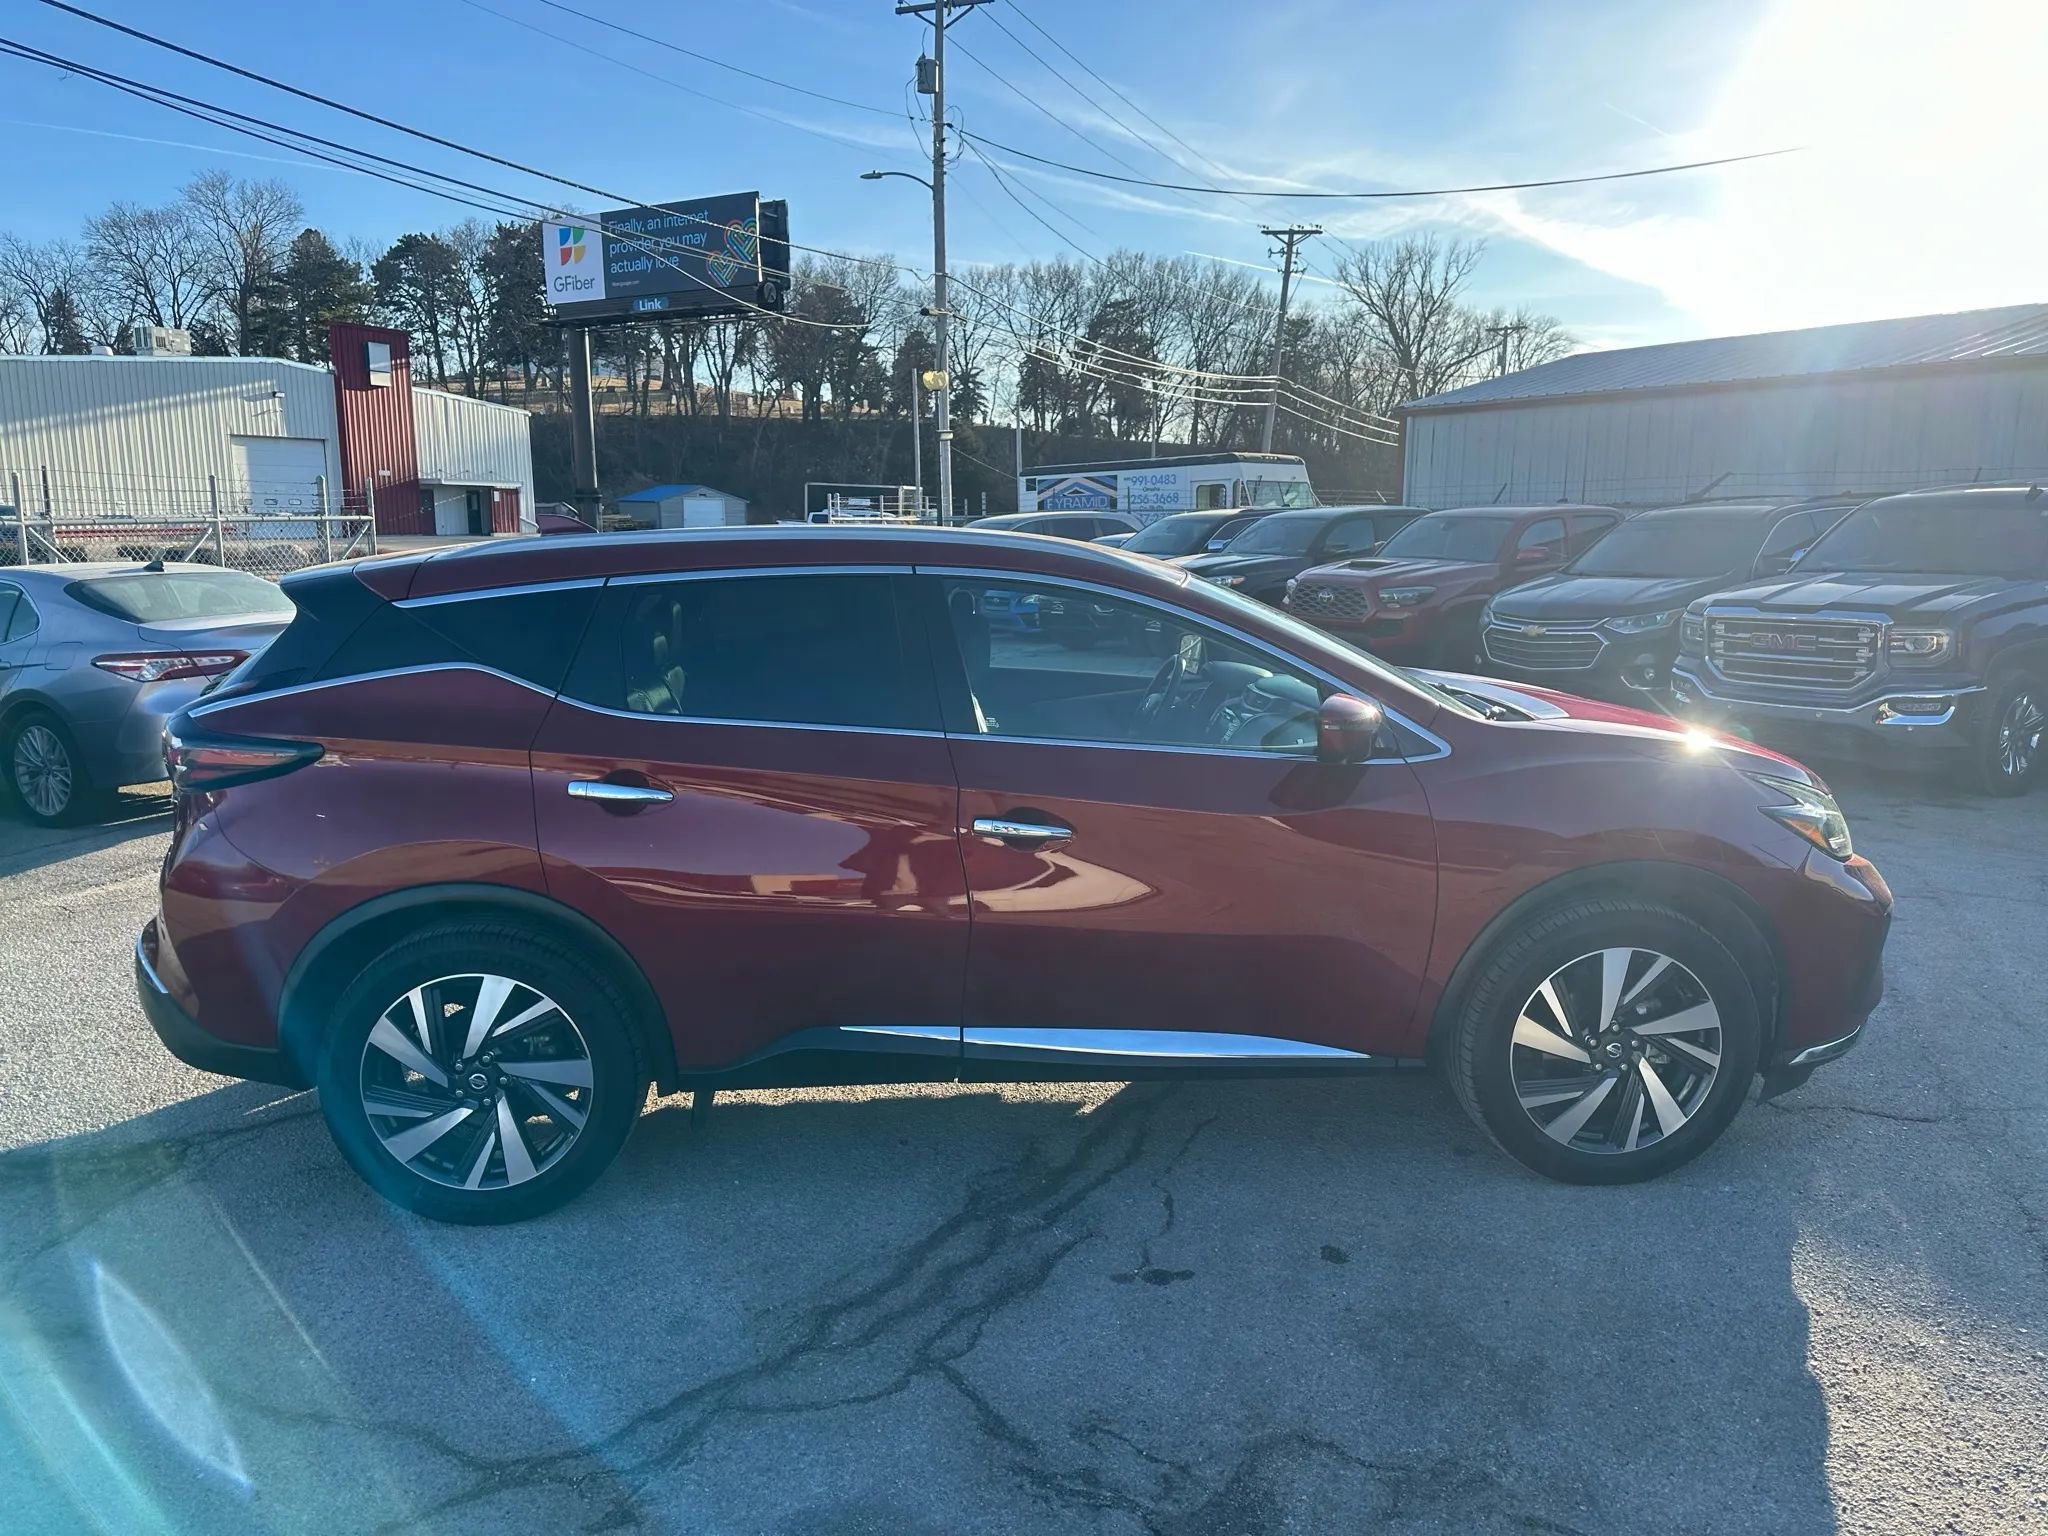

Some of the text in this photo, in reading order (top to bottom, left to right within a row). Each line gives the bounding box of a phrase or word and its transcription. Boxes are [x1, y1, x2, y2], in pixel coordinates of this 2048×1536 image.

[608, 209, 709, 234] Finally, an internet
[658, 234, 680, 253] you
[682, 232, 708, 247] may
[610, 254, 680, 274] actually love
[554, 275, 595, 293] GFiber
[639, 297, 663, 312] Link
[1131, 473, 1177, 486] 991-0483
[1047, 495, 1108, 510] PYRAMID
[1131, 491, 1180, 504] 256-3668
[1750, 632, 1817, 651] GMC
